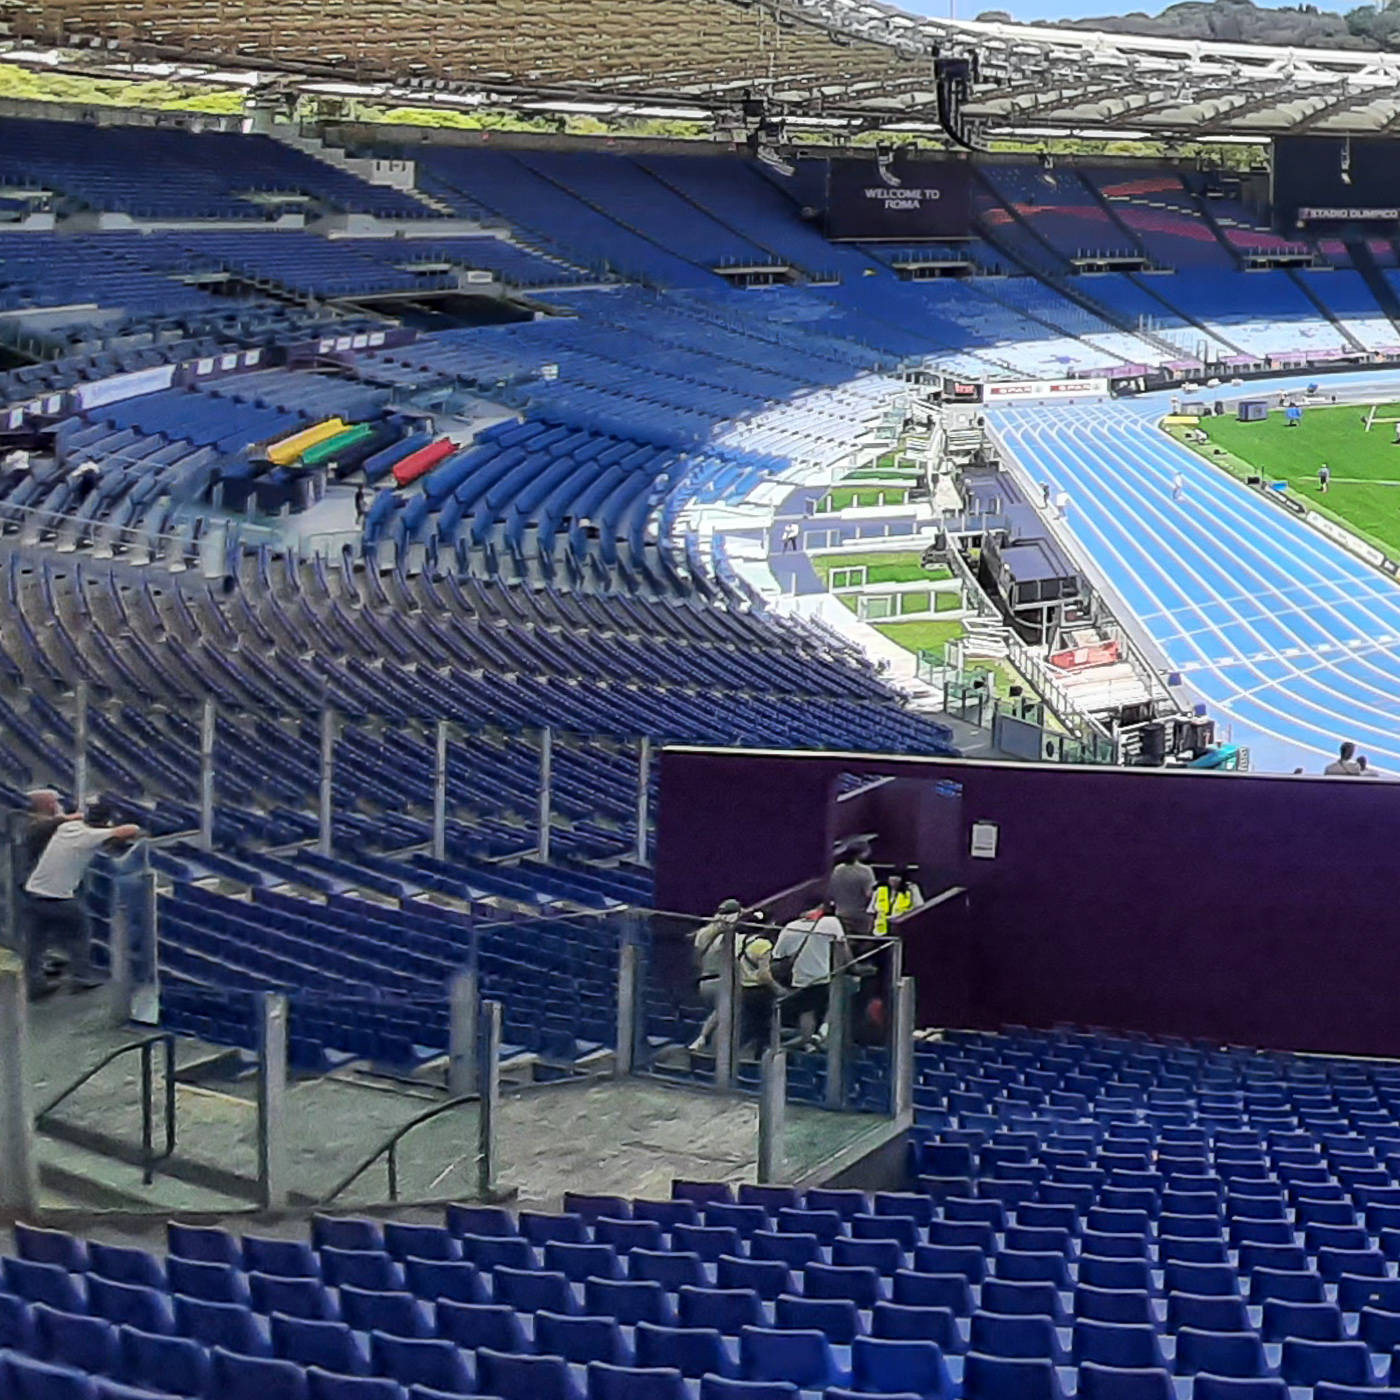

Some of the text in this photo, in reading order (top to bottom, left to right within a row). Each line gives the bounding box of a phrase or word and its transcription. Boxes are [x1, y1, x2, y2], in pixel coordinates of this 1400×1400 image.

[864, 189, 940, 200] WELCOME TO
[885, 200, 920, 209] ROMA
[1309, 208, 1398, 219] STADIO OLIMPICO
